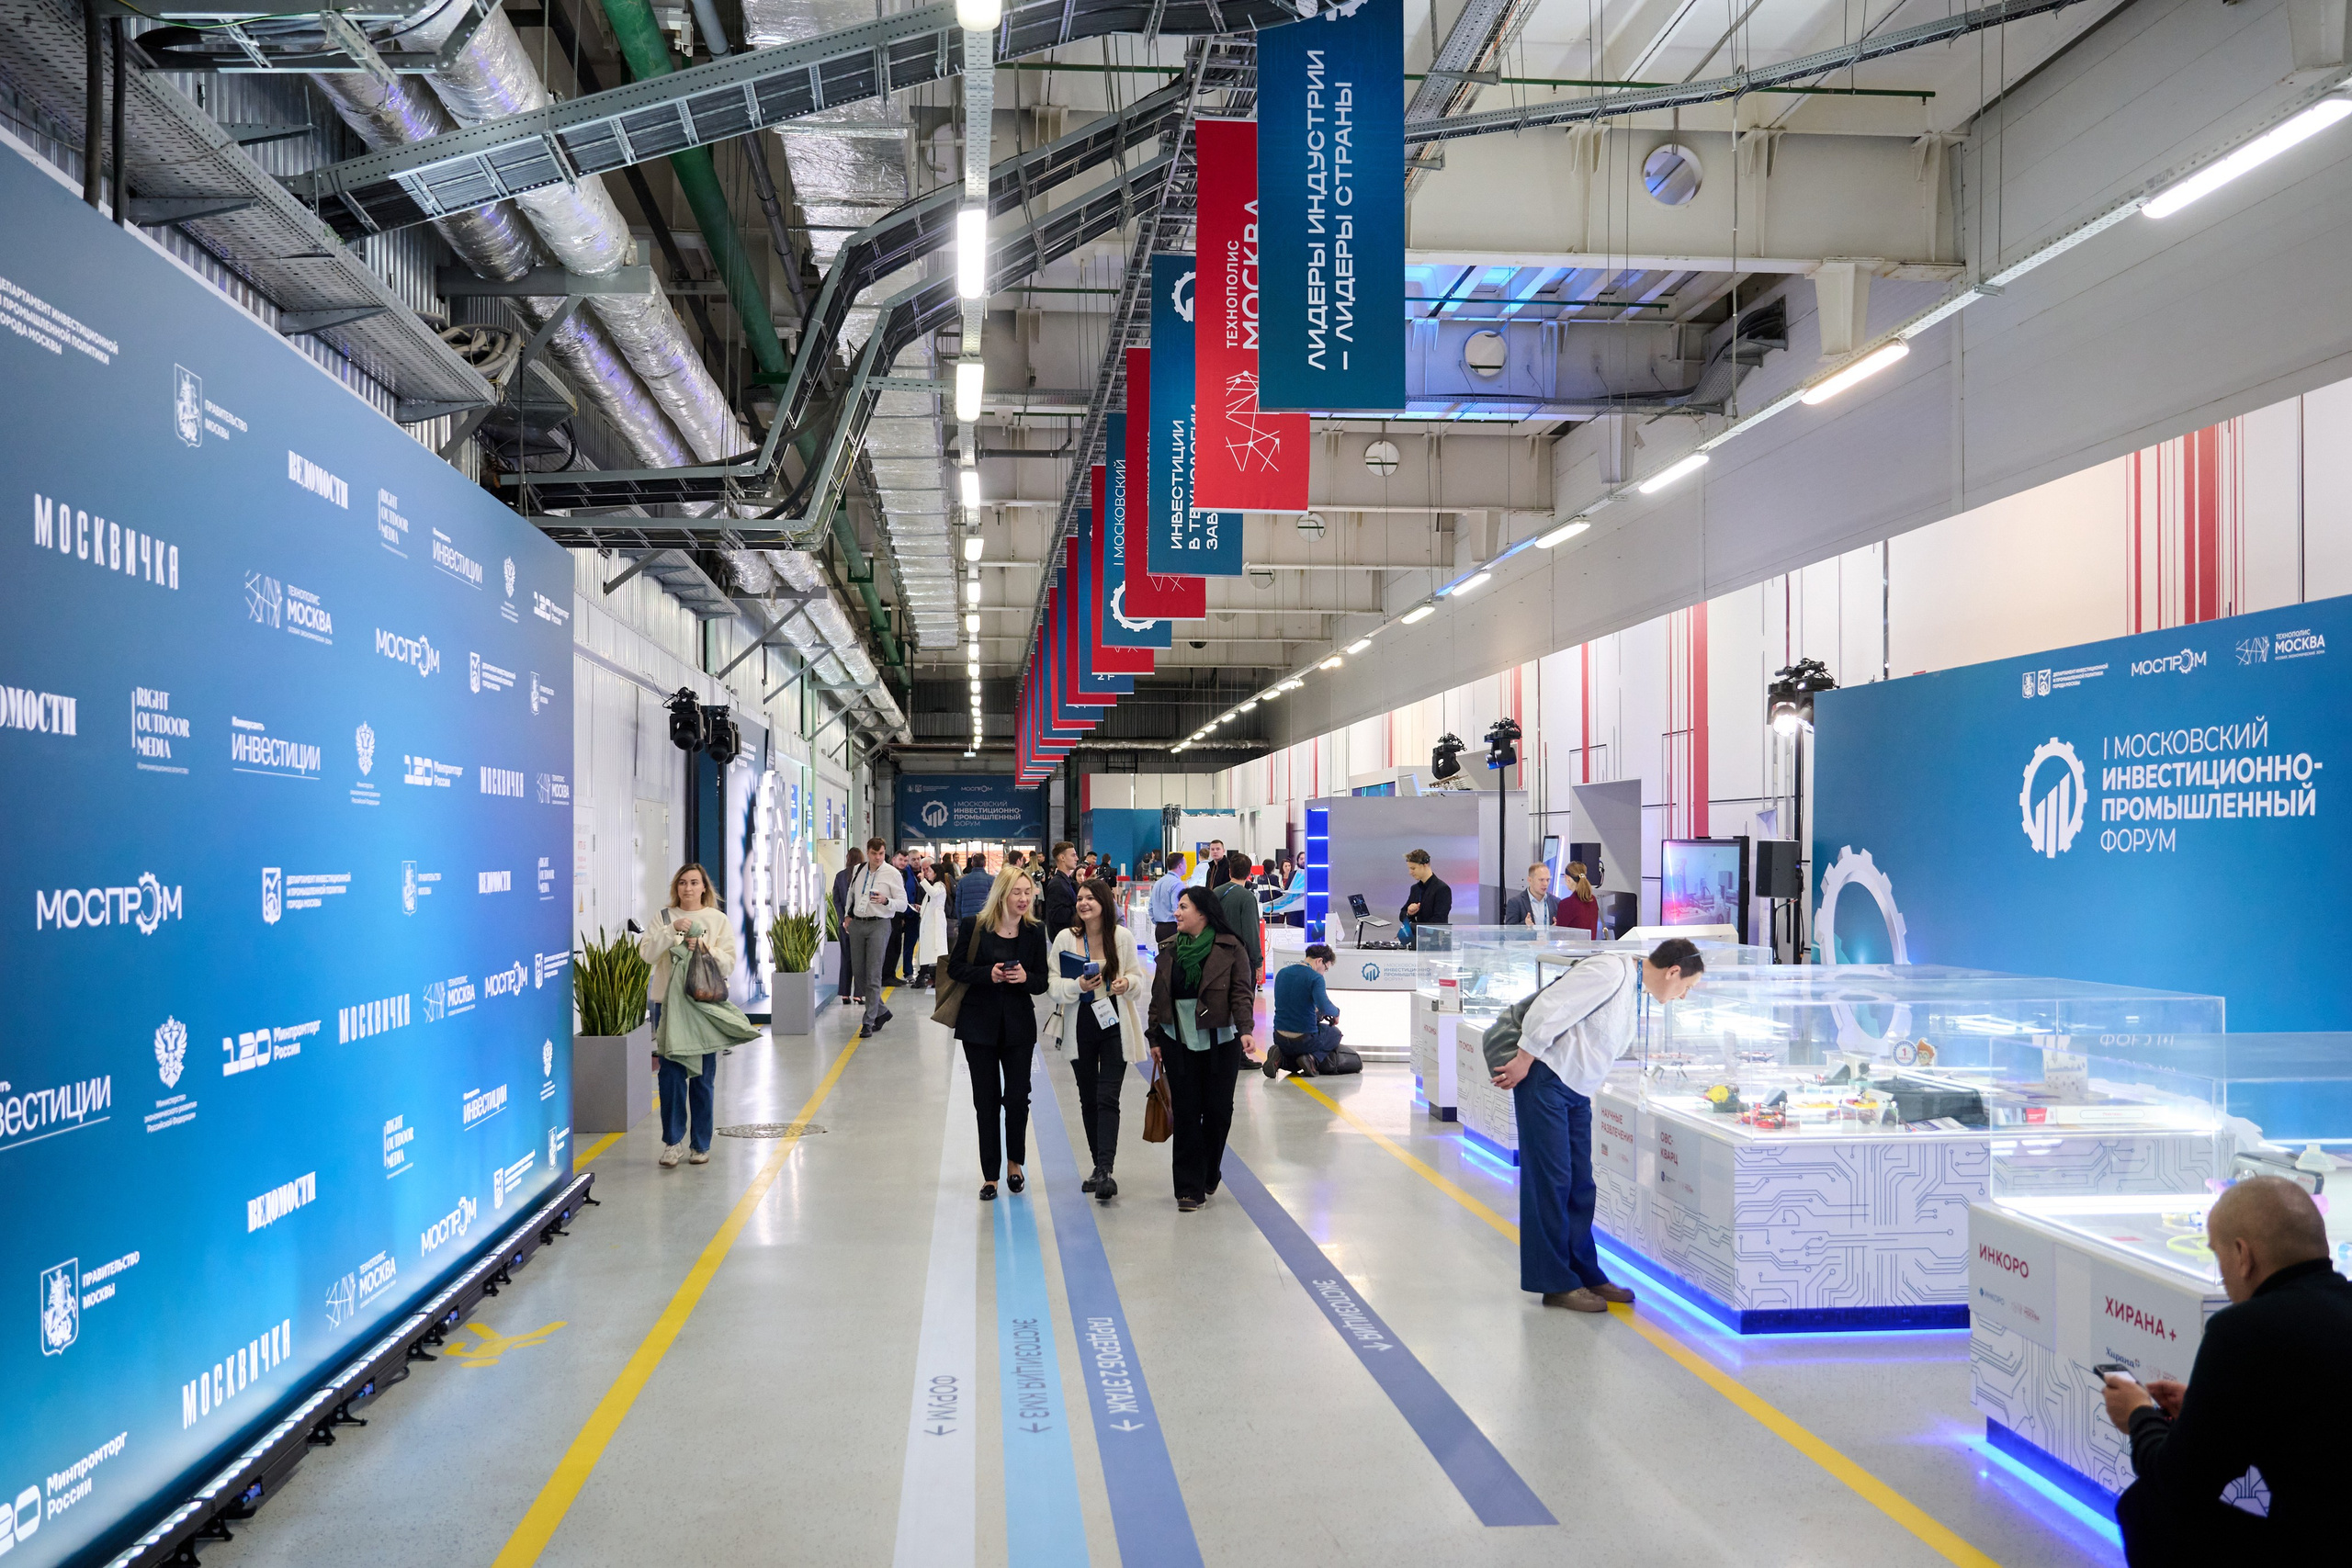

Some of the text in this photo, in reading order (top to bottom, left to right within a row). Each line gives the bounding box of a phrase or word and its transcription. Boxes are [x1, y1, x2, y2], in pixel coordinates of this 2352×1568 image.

[1335, 82, 1353, 207] СТРАНЫ
[1306, 50, 1328, 371] ЛИДЕРЫ ИНДУСТРИИ
[1226, 240, 1239, 348] ТЕХНОПОЛИС
[1336, 215, 1355, 343] ЛИДЕРЫ
[3, 296, 109, 366] ПРОМЫШЛЕННОЙ ПОЛИТИКИ
[28, 327, 62, 355] МОСКВЫ
[51, 307, 119, 355] ИНВЕСТИЦИОННОЙ
[205, 400, 248, 433] ПРАВИТЕЛЬСТВО
[205, 418, 230, 441] МОСКВЫ
[288, 449, 349, 510] ВЕДОМОСТИ
[1170, 420, 1185, 549] ИНВЕСТИЦИИ
[1114, 459, 1126, 558] МОСКОВСКИЙ
[34, 492, 179, 591] МОСКВИЧКА
[1189, 537, 1201, 550] В
[1206, 512, 1218, 550] ЗАВ
[287, 598, 333, 635] МОСКВА
[2276, 628, 2311, 640] ТЕХНОПОЛИС
[2131, 648, 2207, 676] МОСПРОМ
[2275, 634, 2325, 654] МОСКВА
[137, 686, 170, 711] RIGHT
[138, 711, 190, 739] OUTDOOR
[2113, 716, 2269, 759] МОСКОВСКИЙ
[137, 736, 172, 759] MEDIA
[481, 765, 525, 798] МОСКВИЧКА
[2102, 752, 2324, 791] ИНВЕСТИЦИОННО-
[2101, 783, 2316, 823] ПРОМЫШЛЕННЫЙ
[2099, 827, 2177, 853] ФОРУМ
[37, 871, 183, 936] МОСПРОМ
[447, 984, 475, 1008] МОСКВА
[274, 1020, 322, 1043] Минпромторг
[339, 993, 410, 1044] МОСКВИЧКА
[274, 1042, 301, 1061] России
[1601, 1107, 1623, 1124] НАУЧНЫЕ
[1601, 1122, 1634, 1145] РАЗВЛЕЧЕНИЯ
[1660, 1147, 1678, 1167] КВАРЦ
[247, 1171, 316, 1233] ВЕДОМОСТИ
[83, 1251, 140, 1288] ПРАВИТЕЛЬСТВО
[359, 1257, 396, 1299] МОСКВА
[1979, 1243, 2029, 1279] ИНКОРО
[83, 1282, 116, 1310] МОСКВЫ
[1312, 1279, 1385, 1340] ЭКСПОЗИЦИЯ
[2105, 1295, 2165, 1340] ХИРАНА
[183, 1318, 290, 1430] МОСКВИЧКА
[1011, 1318, 1050, 1419] ЭКСПОЗИЦИЯ КМЗ
[1085, 1316, 1139, 1414] ГАРДЕРОБ 2 ЭТАЖ
[2106, 1347, 2134, 1368] Хирана
[927, 1375, 959, 1421] ФОРУМ
[47, 1431, 128, 1497] Минпромторг
[47, 1477, 92, 1521] России
